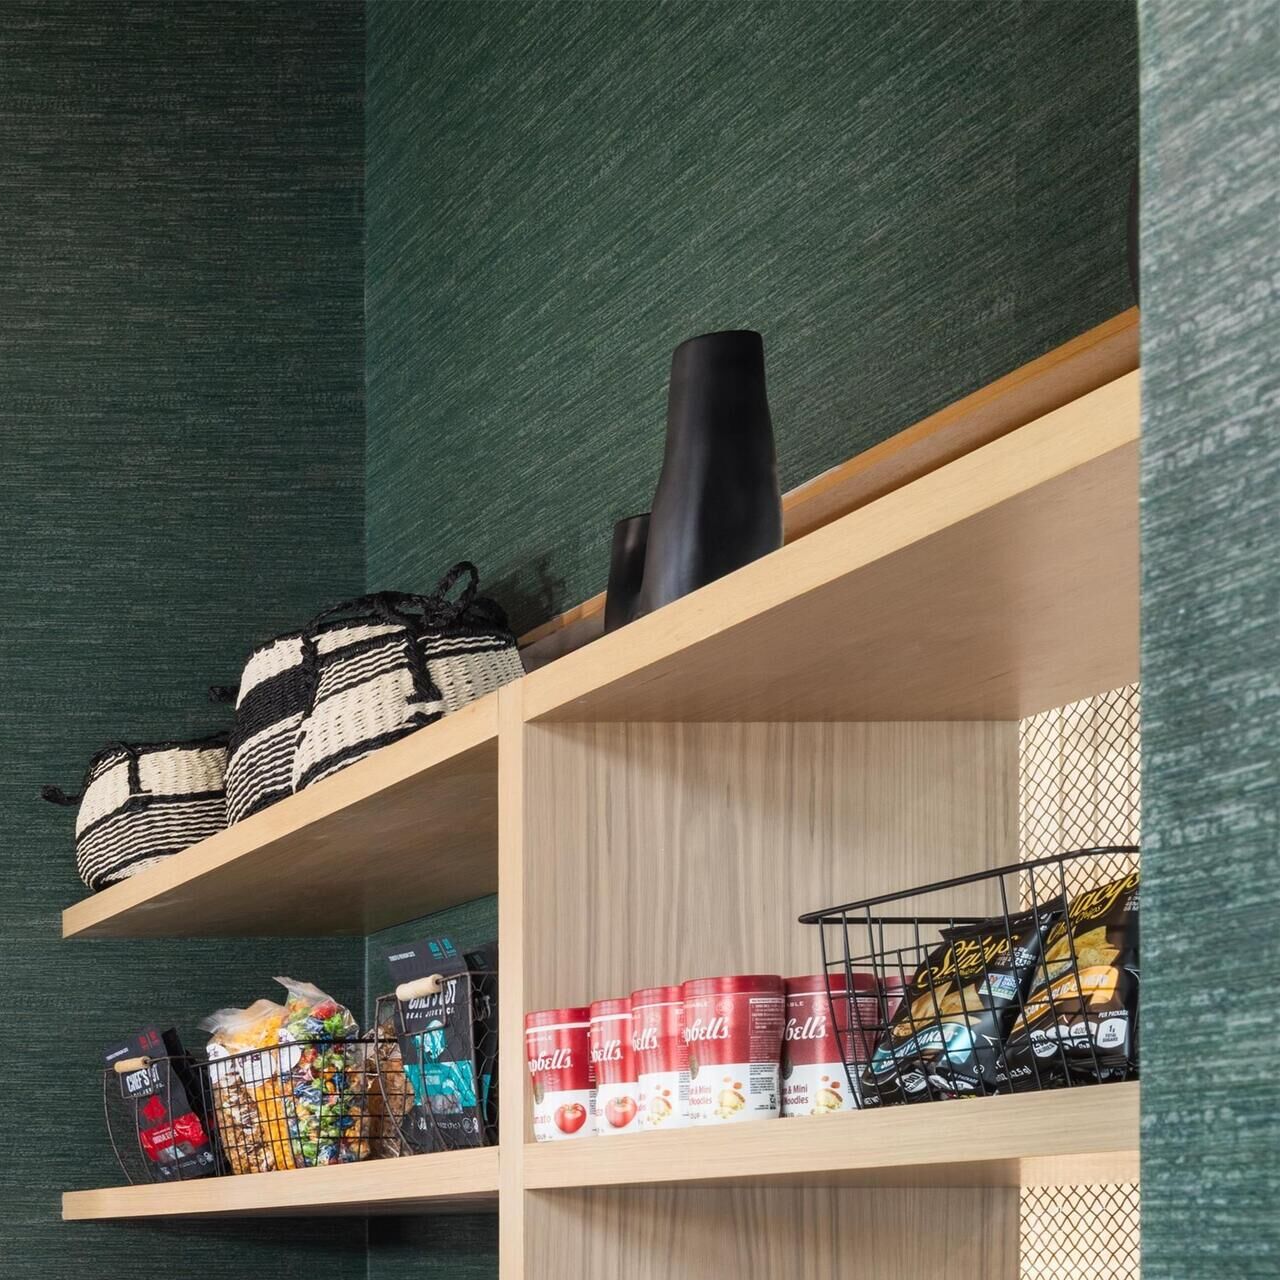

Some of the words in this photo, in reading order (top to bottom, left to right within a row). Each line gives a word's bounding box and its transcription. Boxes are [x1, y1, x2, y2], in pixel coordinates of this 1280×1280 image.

[917, 935, 1019, 989] Stacy's
[1108, 1009, 1129, 1018] PACKAGE
[126, 1068, 151, 1093] CHEF'S
[793, 1084, 808, 1094] Mini
